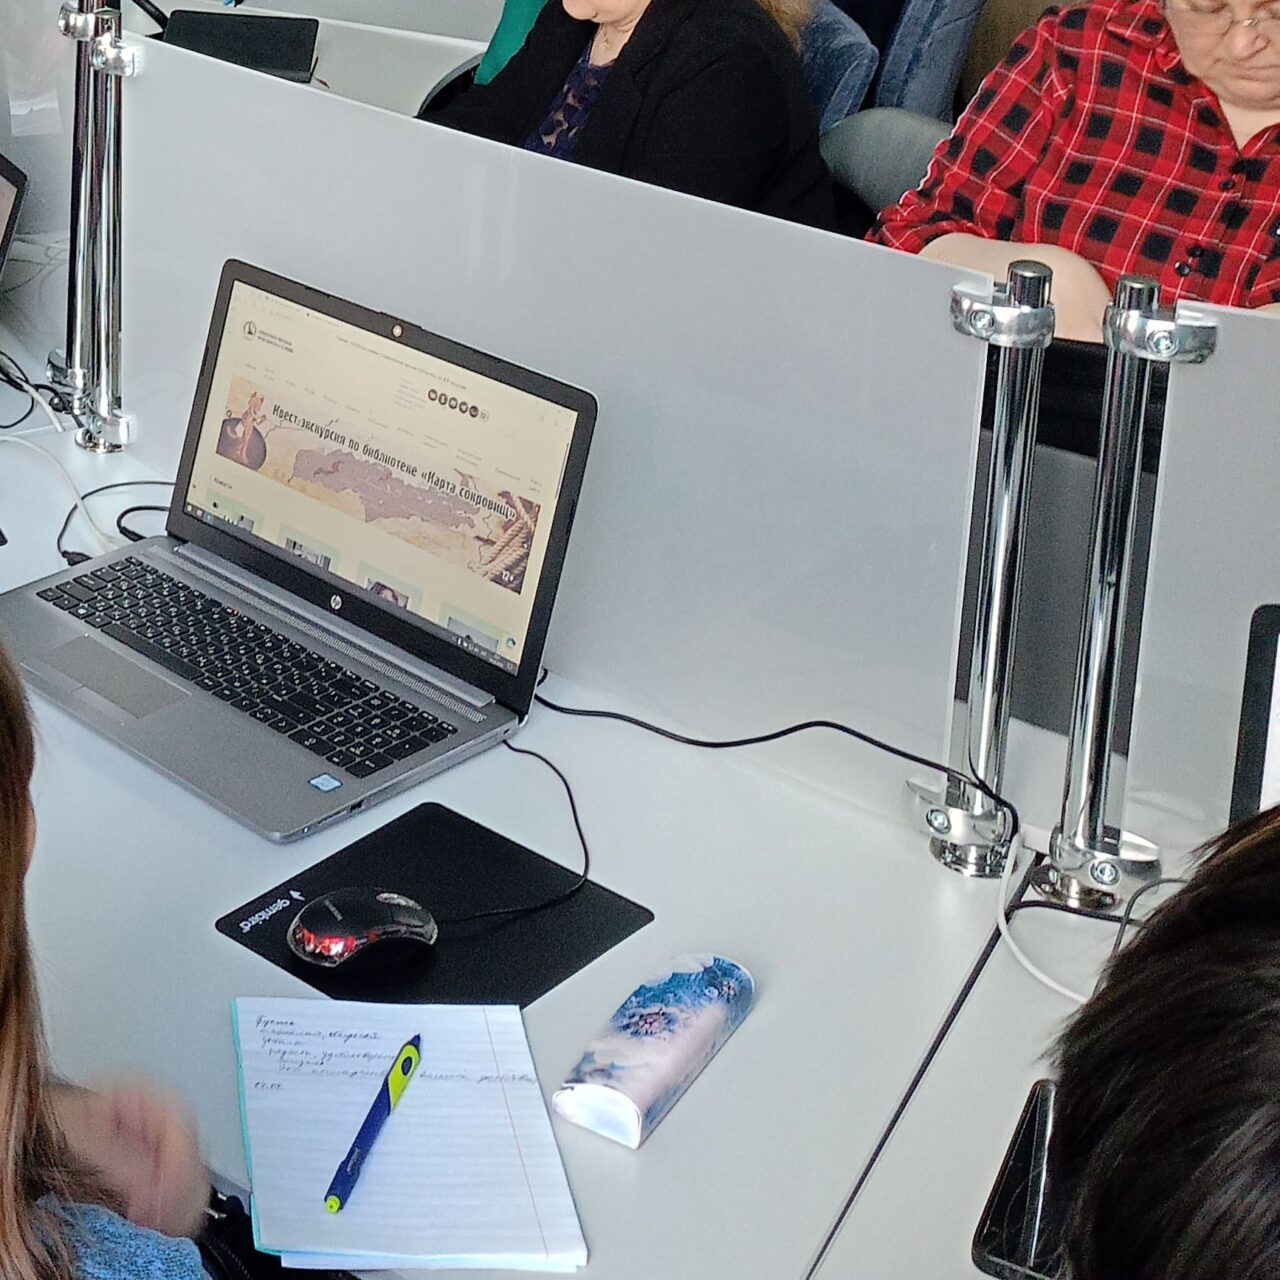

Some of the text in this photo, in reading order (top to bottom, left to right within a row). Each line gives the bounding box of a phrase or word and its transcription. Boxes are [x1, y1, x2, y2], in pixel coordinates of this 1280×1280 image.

[348, 438, 360, 452] по
[362, 444, 418, 477] библиотеке
[421, 471, 456, 494] «Карта
[459, 486, 516, 520] сокровищ»
[238, 897, 291, 934] gembird
